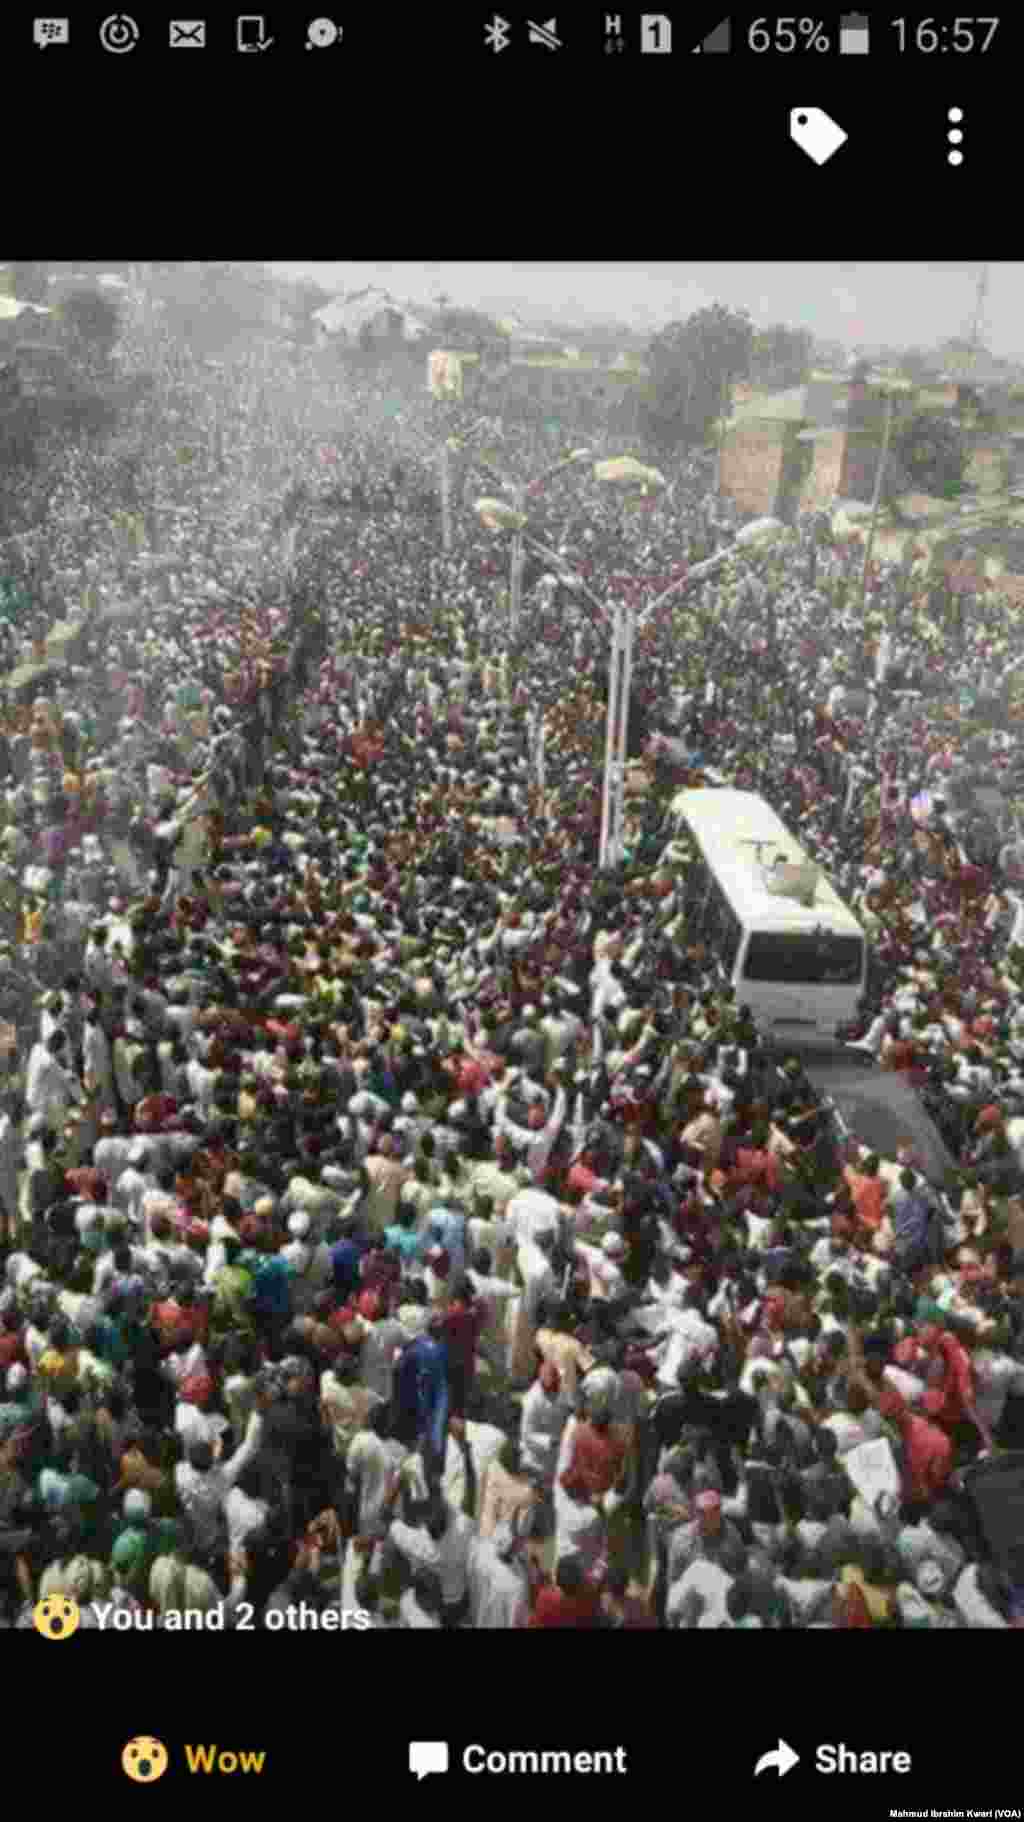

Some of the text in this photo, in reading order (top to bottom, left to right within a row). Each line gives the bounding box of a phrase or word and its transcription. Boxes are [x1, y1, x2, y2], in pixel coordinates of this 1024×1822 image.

[605, 15, 621, 35] H
[747, 17, 830, 53] 65%
[890, 17, 1000, 53] 16:57
[91, 1602, 371, 1630] You and 2 others
[184, 1744, 267, 1774] Wow
[462, 1743, 627, 1774] Comment
[815, 1743, 912, 1774] Share
